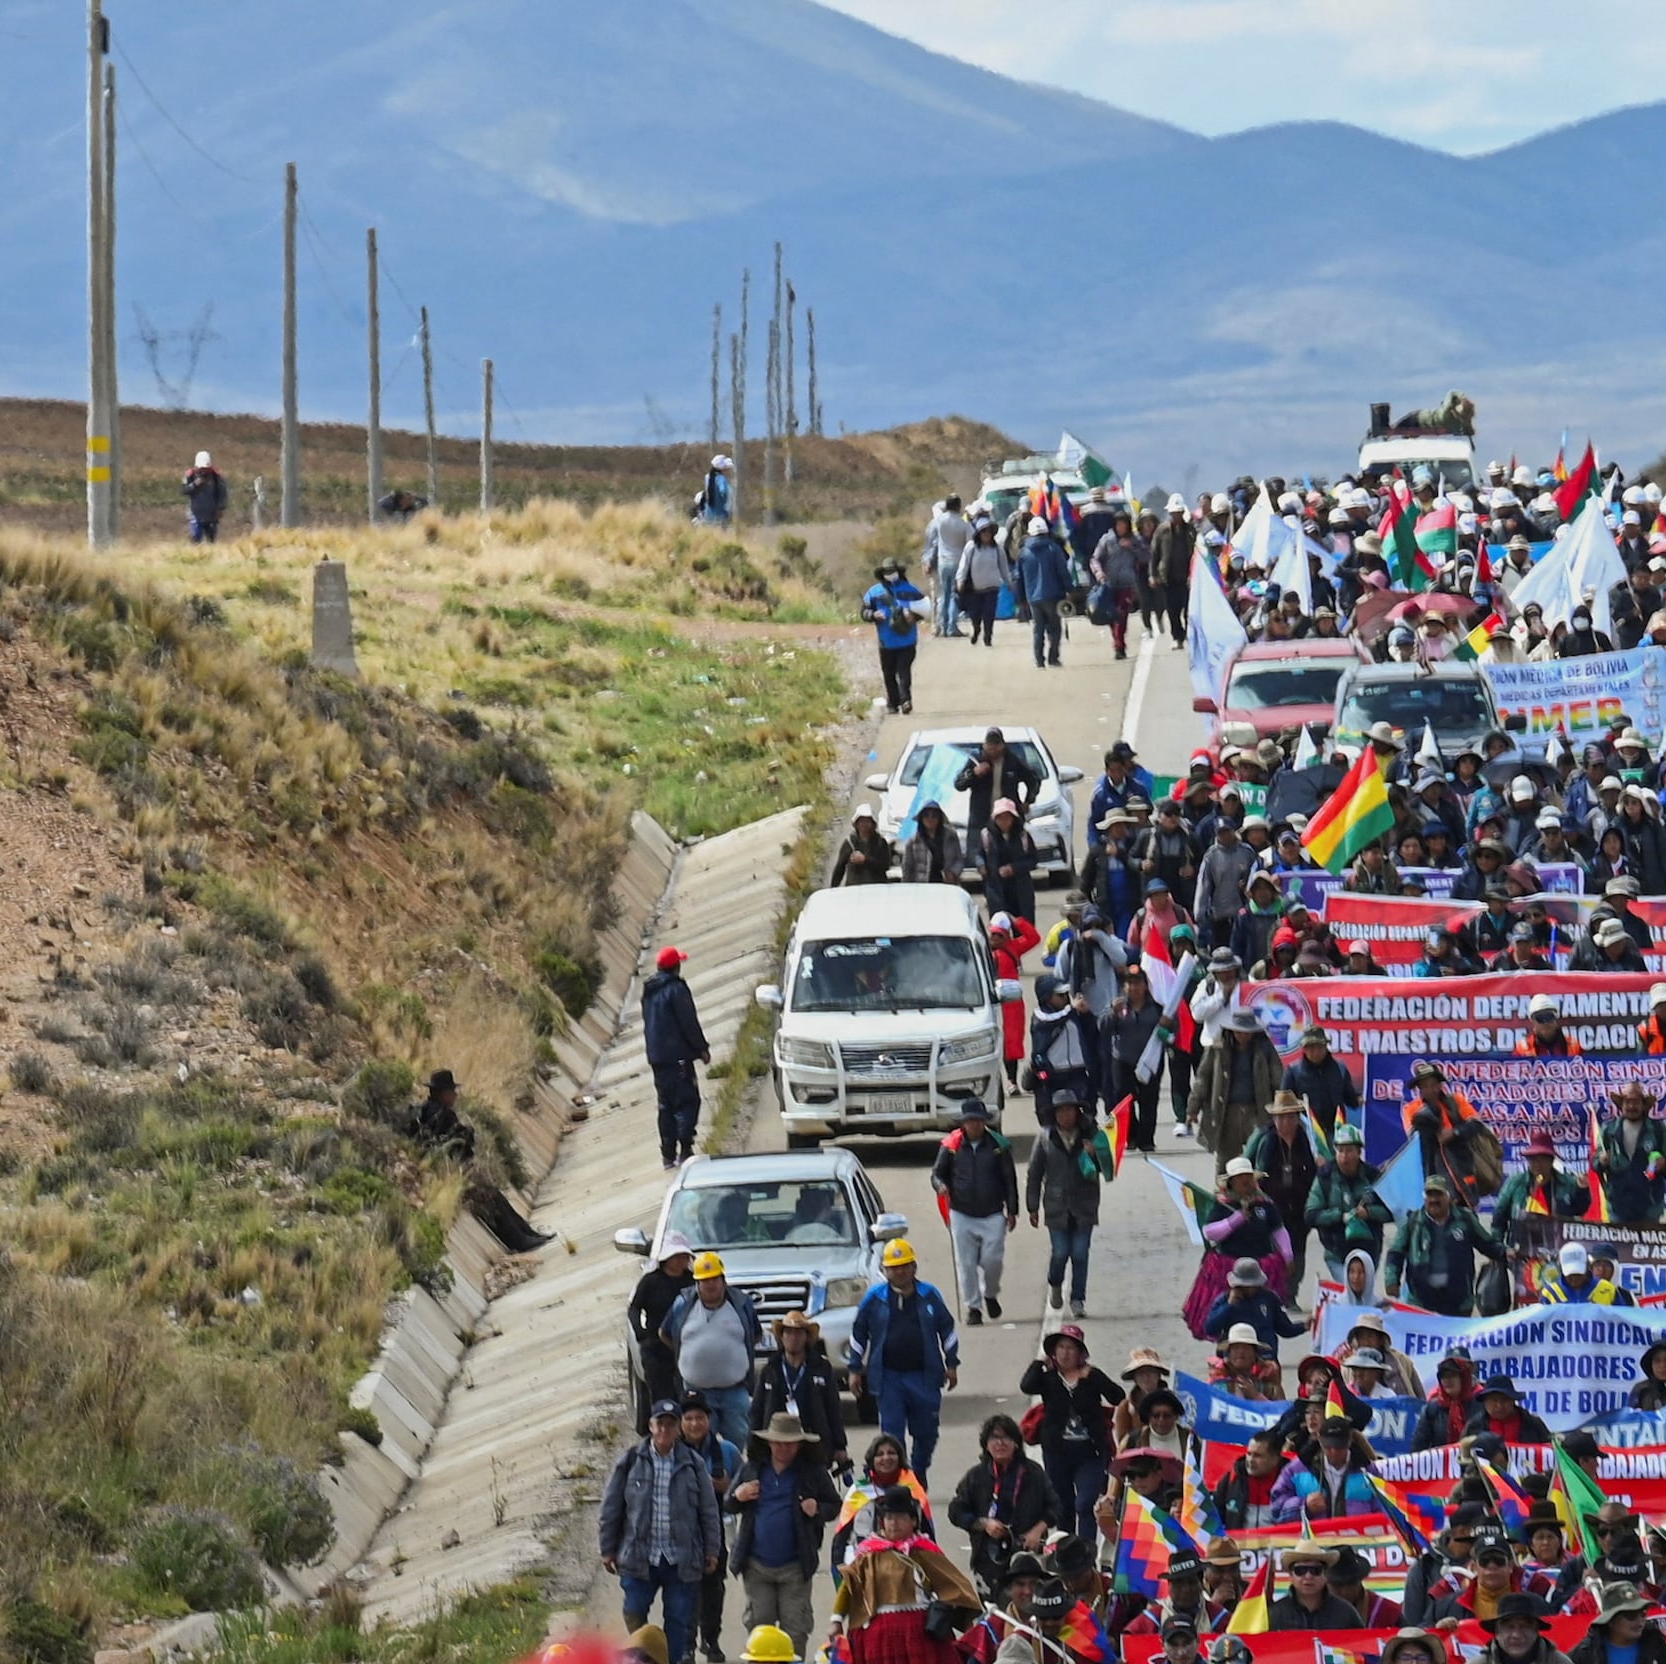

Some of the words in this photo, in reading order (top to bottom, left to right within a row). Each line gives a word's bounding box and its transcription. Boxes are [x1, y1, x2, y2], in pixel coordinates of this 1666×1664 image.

[1585, 657, 1629, 677] BOLIVIA
[1317, 993, 1469, 1021] FEDERACIÓN
[1474, 991, 1652, 1020] DEPATAMENTA
[1359, 1028, 1492, 1054] MAESTROS
[1373, 1079, 1404, 1100] DE
[1412, 1081, 1587, 1103] ABAJADORES
[1562, 1221, 1638, 1244] FEDERACIÓN
[1632, 1244, 1649, 1260] EN
[1551, 1319, 1654, 1347] SINDICAL
[1474, 1355, 1636, 1381] RABAJADORES
[1545, 1390, 1571, 1414] DE
